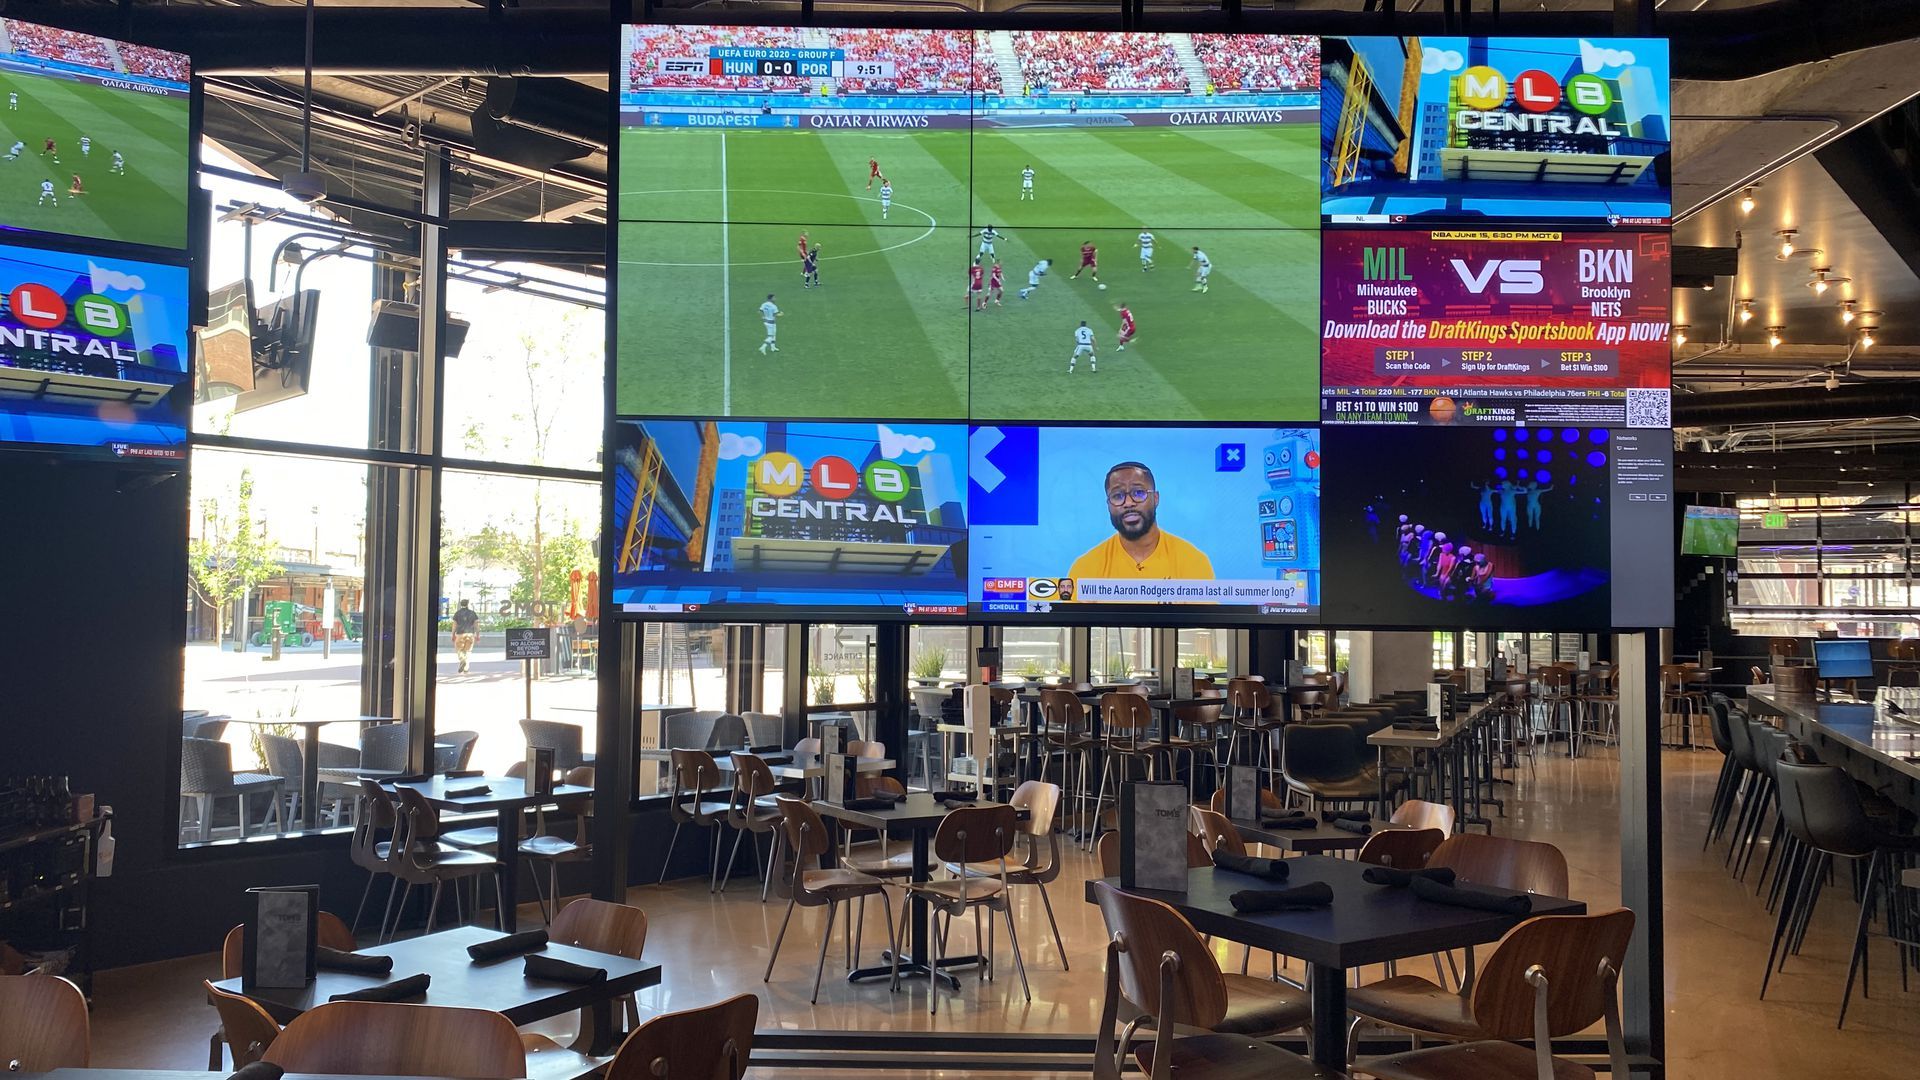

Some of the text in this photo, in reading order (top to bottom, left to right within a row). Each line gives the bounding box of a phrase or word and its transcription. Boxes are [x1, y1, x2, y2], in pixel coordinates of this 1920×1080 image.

[718, 50, 741, 58] UEFA
[742, 50, 767, 58] EURO
[769, 51, 790, 59] 2020
[798, 51, 828, 59] GROUP
[665, 62, 704, 72] ESPN
[725, 62, 828, 75] HUN 0-0 POR
[857, 65, 883, 75] 9:51
[101, 79, 169, 95] QATAR AIRWAYS
[687, 114, 759, 126] BUDAPEST
[810, 115, 929, 128] QATAR AIRWAYS
[1086, 116, 1114, 125] QATAR
[1170, 110, 1283, 125] QATAR AIRWAYS
[1455, 110, 1621, 136] CENTRAL
[1363, 247, 1413, 281] MIL
[1579, 249, 1633, 283] BKN
[1450, 259, 1544, 294] VS
[1356, 284, 1418, 297] Milwaukee
[1582, 286, 1631, 300] Brooklyn
[1367, 300, 1407, 316] BUCKS
[1591, 301, 1622, 317] NETS
[1081, 330, 1087, 340] 5
[1323, 319, 1671, 345] Download the DraftKings Sportsbook App NOW!
[1385, 351, 1415, 361] STEP 1
[1461, 351, 1493, 361] STEP 2
[1560, 352, 1592, 362] STEP 3
[1385, 362, 1431, 370] Scan the Code
[1461, 362, 1475, 372] Sign
[1476, 363, 1485, 372] Up
[1497, 363, 1530, 372] DraftKings
[1572, 363, 1580, 372] $1
[1580, 364, 1593, 372] Win
[1593, 363, 1609, 372] $100
[1523, 390, 1566, 398] Philadelphia
[1336, 401, 1419, 412] BET $1 TO WIN $100
[1463, 405, 1516, 416] DRAFTKINGS
[1336, 412, 1346, 421] ON
[1347, 412, 1361, 421] ANY
[1363, 412, 1382, 421] TEAM
[1383, 413, 1392, 421] TO
[751, 497, 917, 524] CENTRAL
[997, 580, 1024, 589] GMFB
[1081, 584, 1295, 599] Will the Aaron Rodgers drama last all summer long?
[989, 603, 1020, 611] SCHEDULE
[1155, 808, 1180, 818] TOM'S
